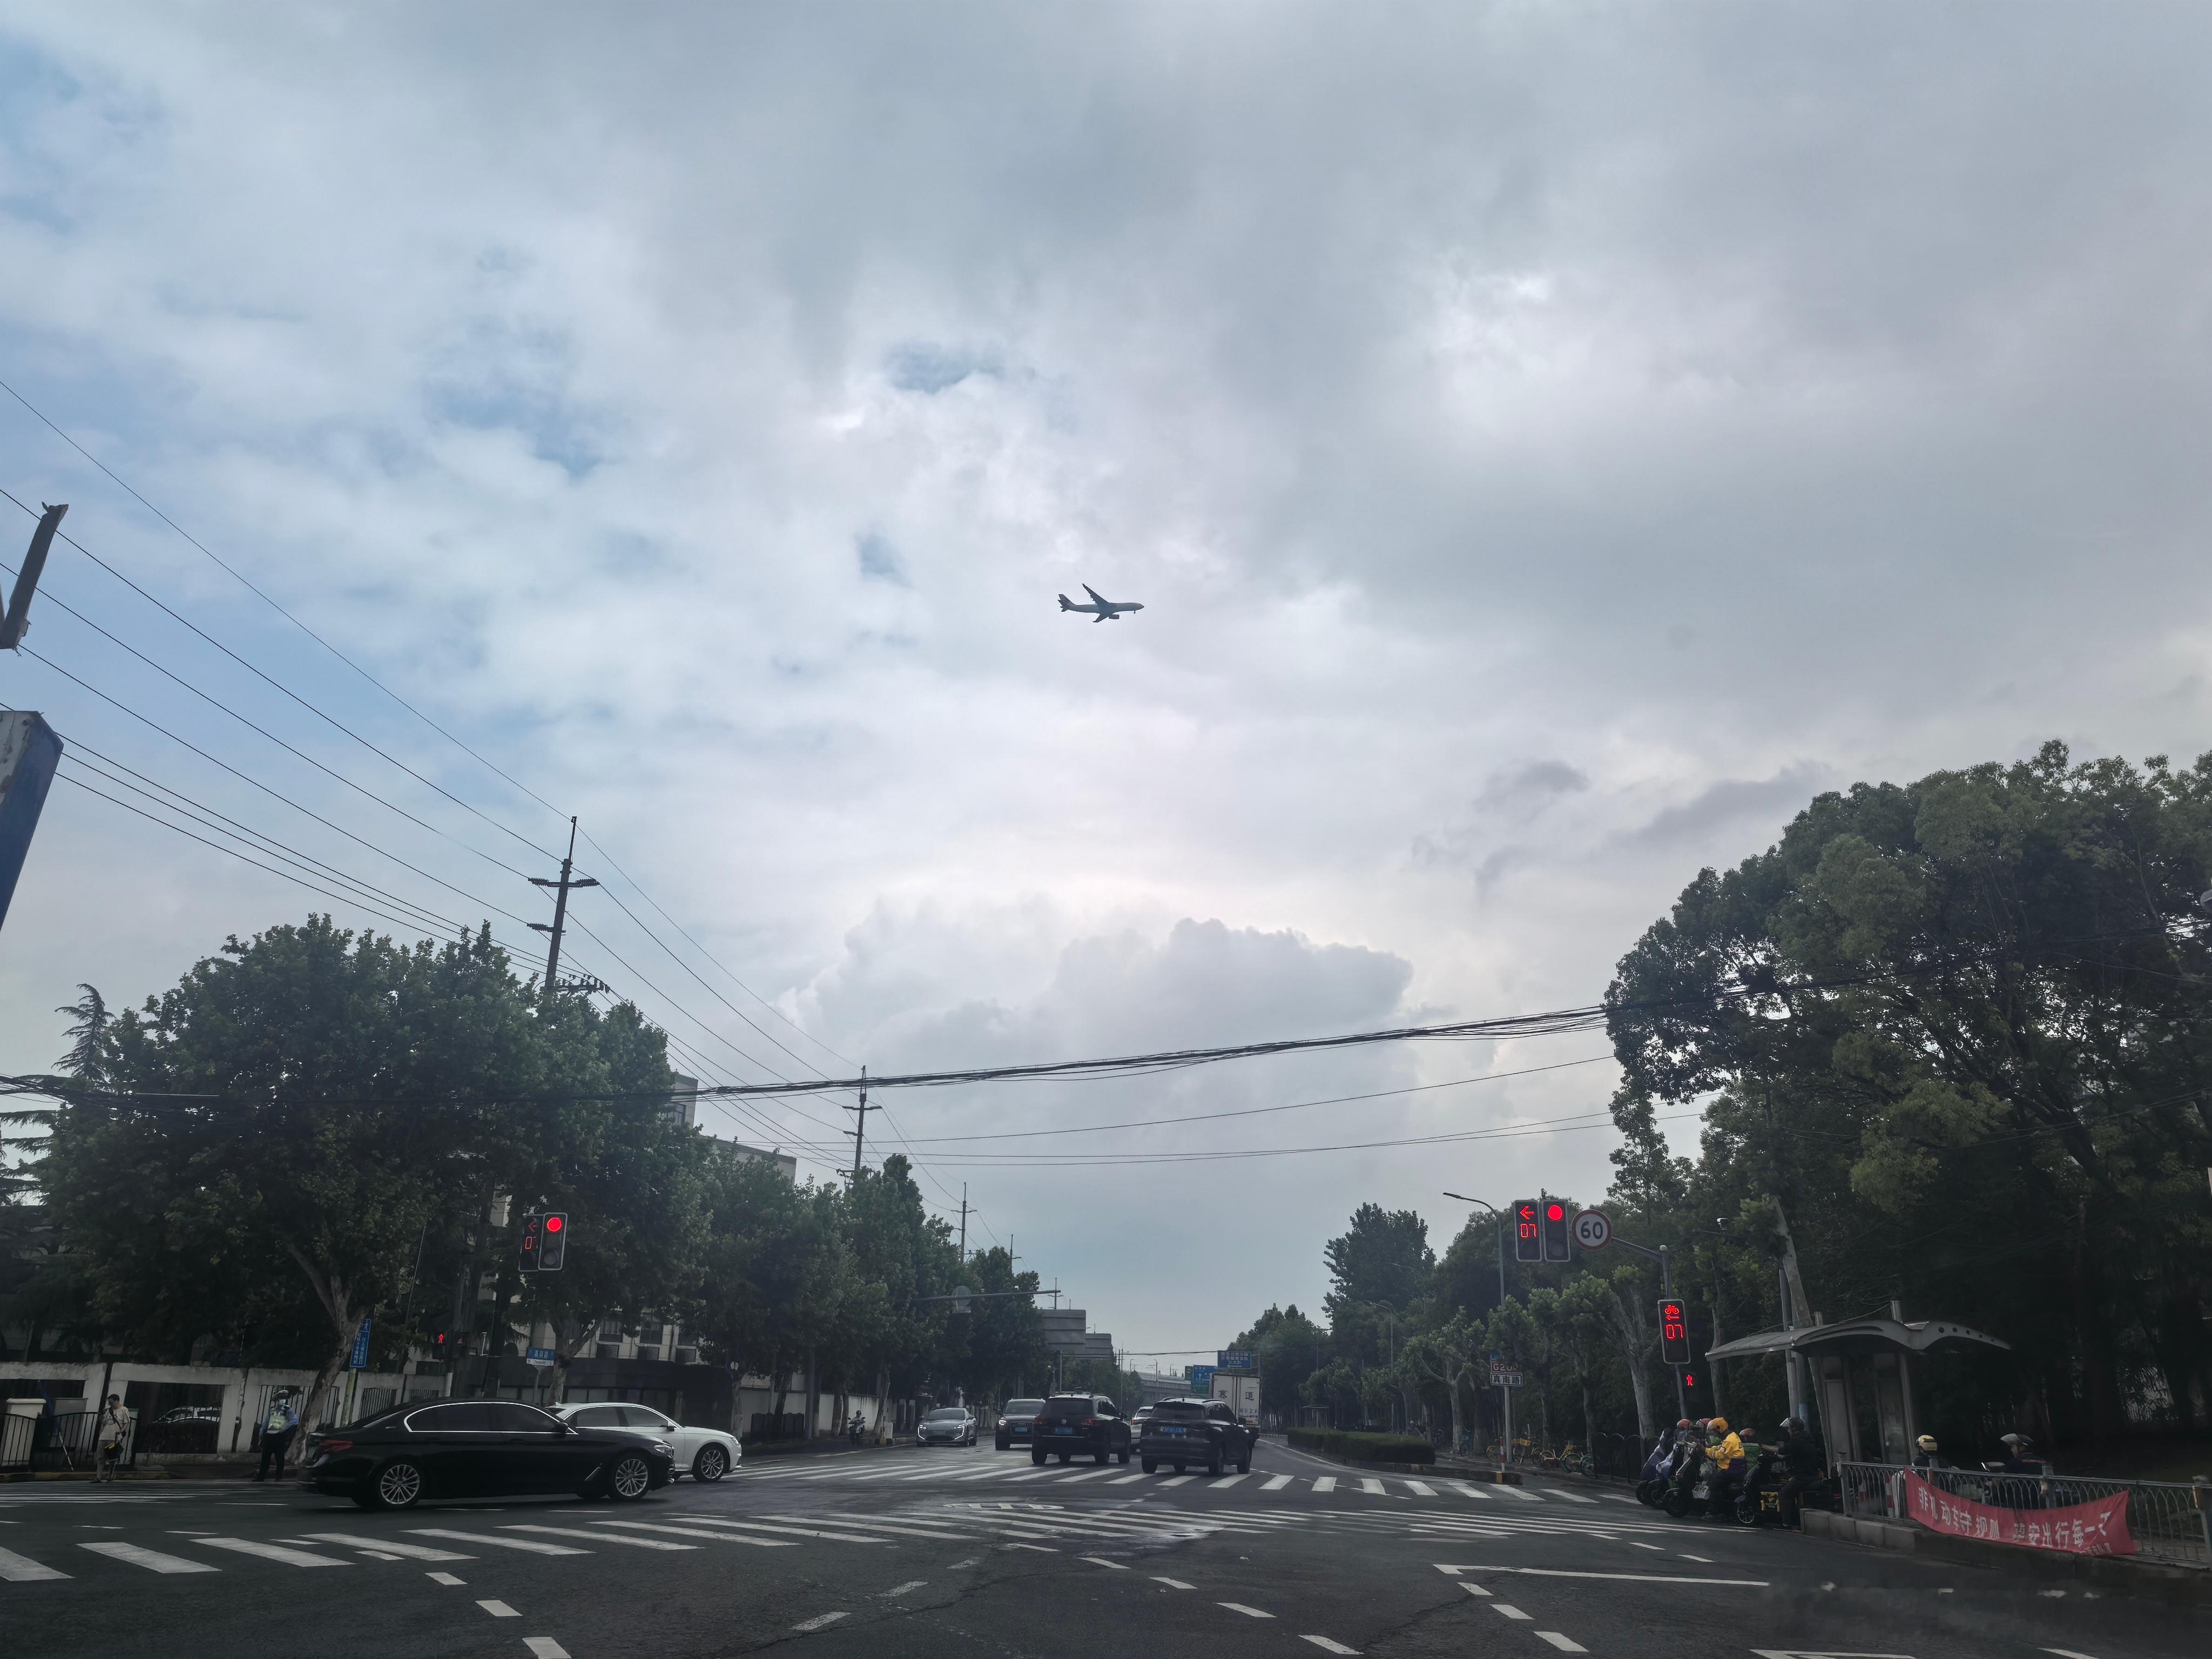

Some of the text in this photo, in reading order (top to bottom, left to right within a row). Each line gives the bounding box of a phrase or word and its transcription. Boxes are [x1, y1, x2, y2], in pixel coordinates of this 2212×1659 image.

[1520, 1223, 1537, 1238] 07
[1581, 1221, 1603, 1239] 60
[1665, 1324, 1683, 1339] 07
[1493, 1375, 1520, 1384] 真南路
